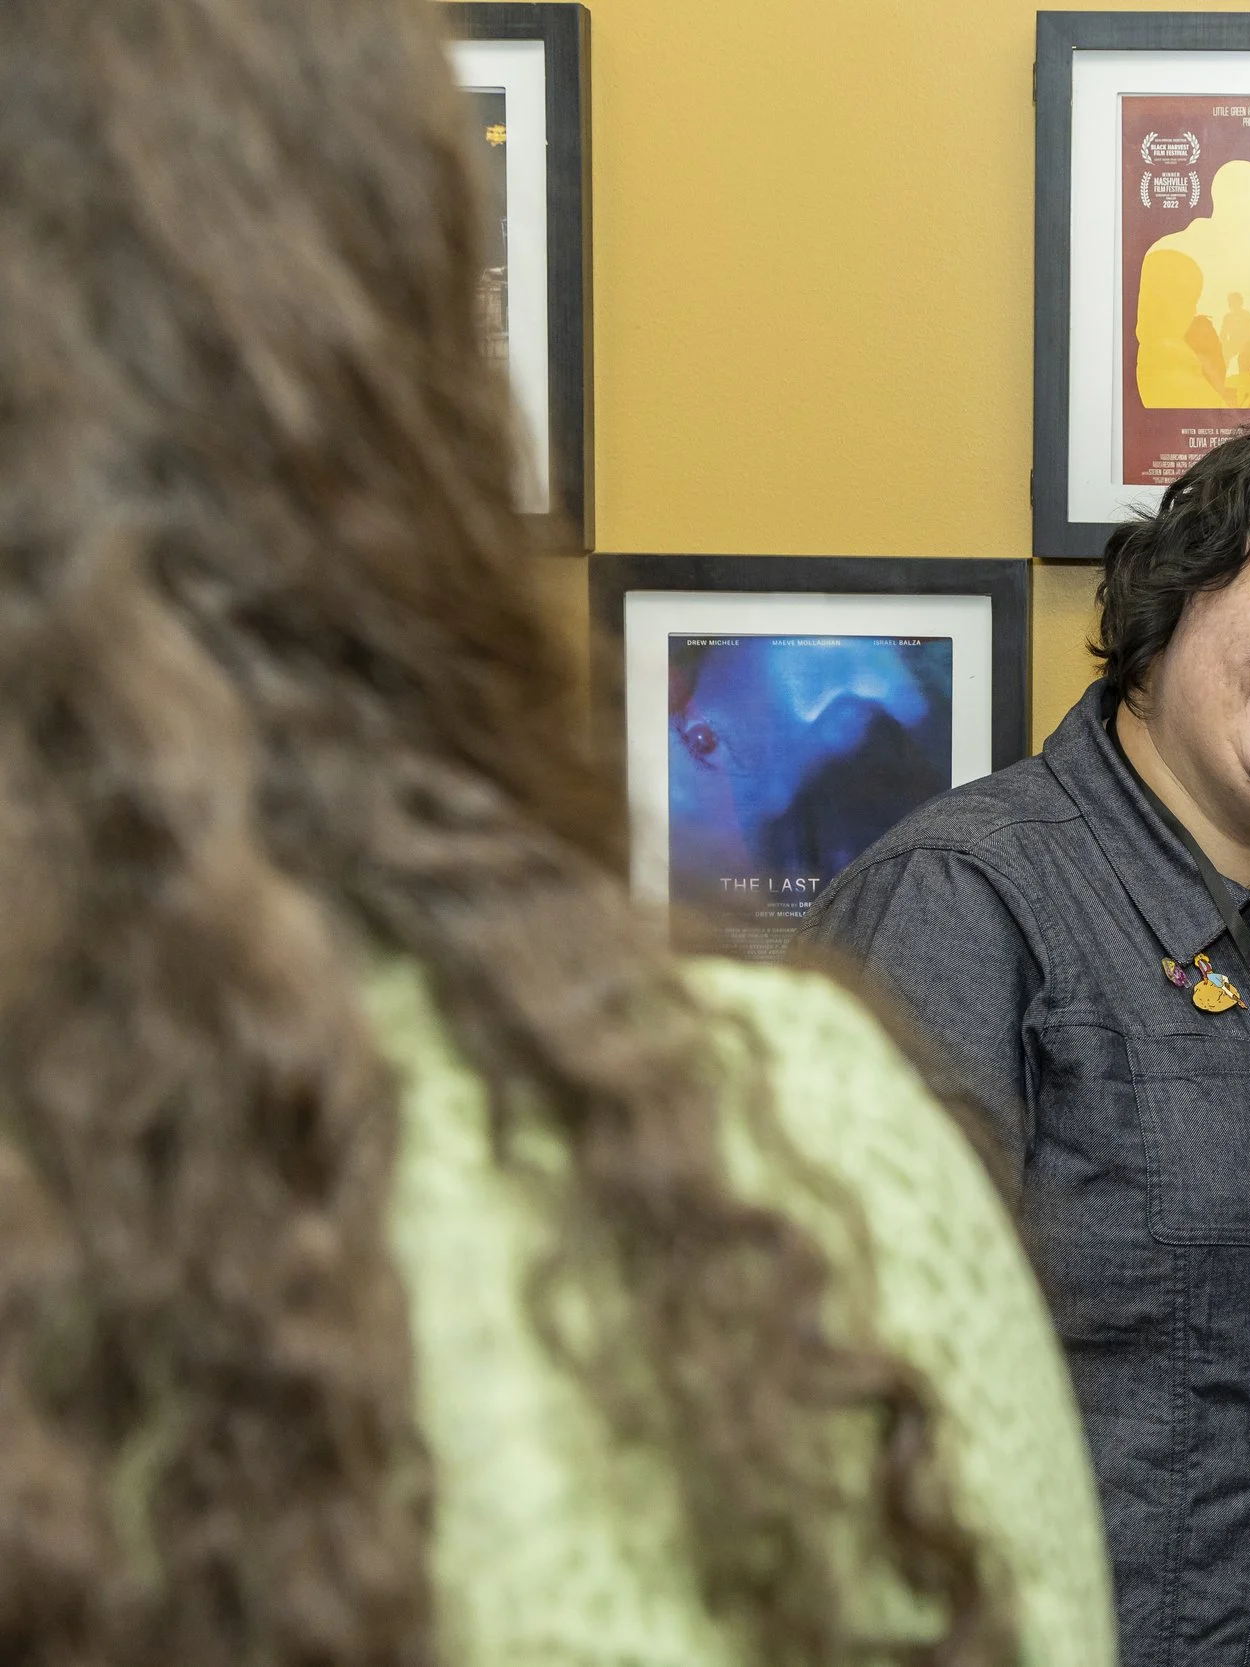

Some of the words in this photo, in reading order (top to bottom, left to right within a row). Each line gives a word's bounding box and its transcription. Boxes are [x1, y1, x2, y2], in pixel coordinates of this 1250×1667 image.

[1213, 107, 1229, 116] LITTLE
[1231, 107, 1246, 116] GREEN
[1154, 177, 1188, 185] NASHVILLE
[1189, 437, 1207, 448] OLIVIA
[720, 878, 760, 892] THE
[769, 878, 820, 893] LAST
